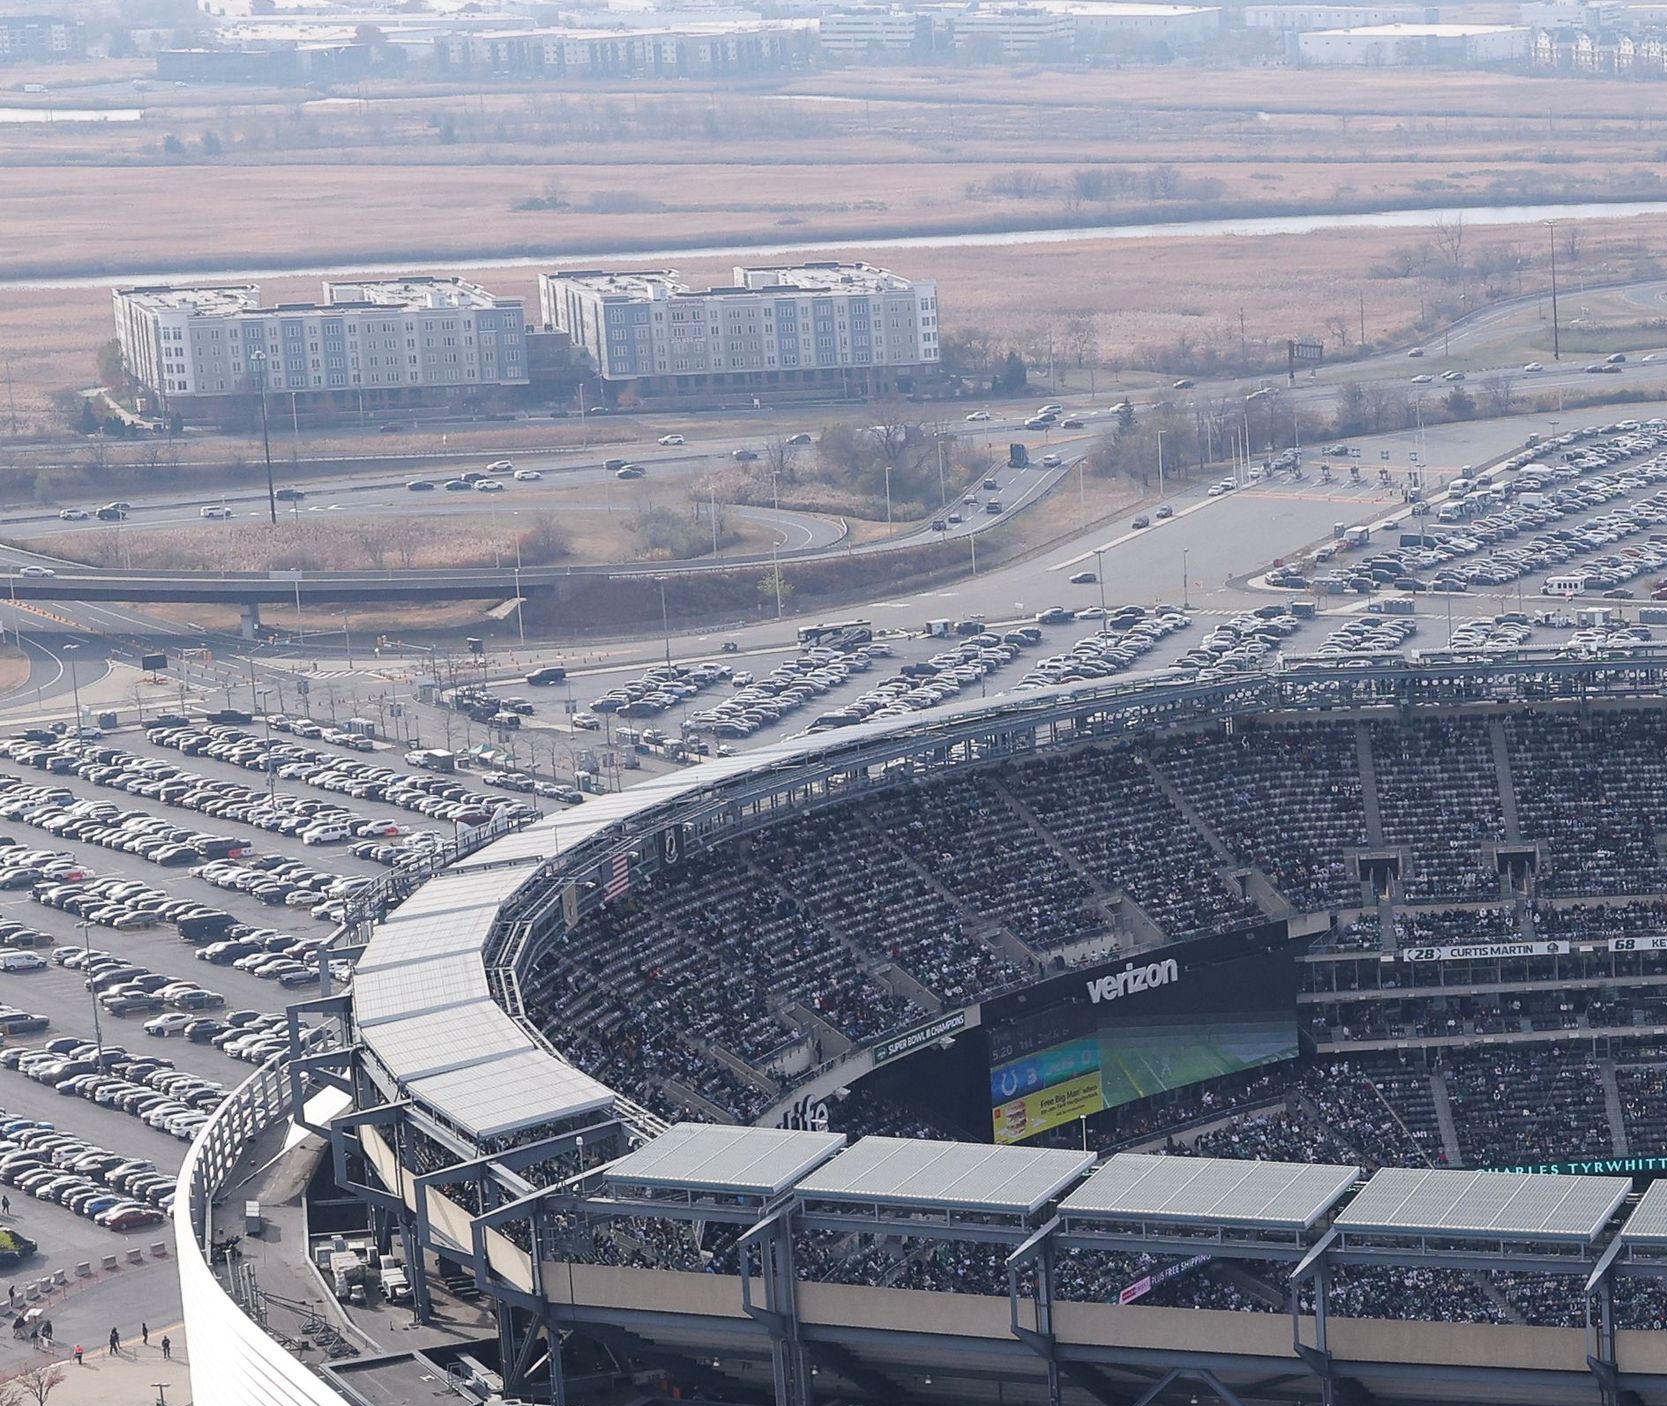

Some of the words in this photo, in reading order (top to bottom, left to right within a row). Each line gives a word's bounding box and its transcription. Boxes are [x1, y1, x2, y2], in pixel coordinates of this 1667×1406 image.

[1413, 947, 1435, 960] 28
[1449, 946, 1489, 957] CURTIS
[1490, 944, 1533, 956] MARTIN
[1613, 939, 1636, 950] 68
[1086, 957, 1179, 1004] verizon
[888, 1039, 907, 1055] SUPER
